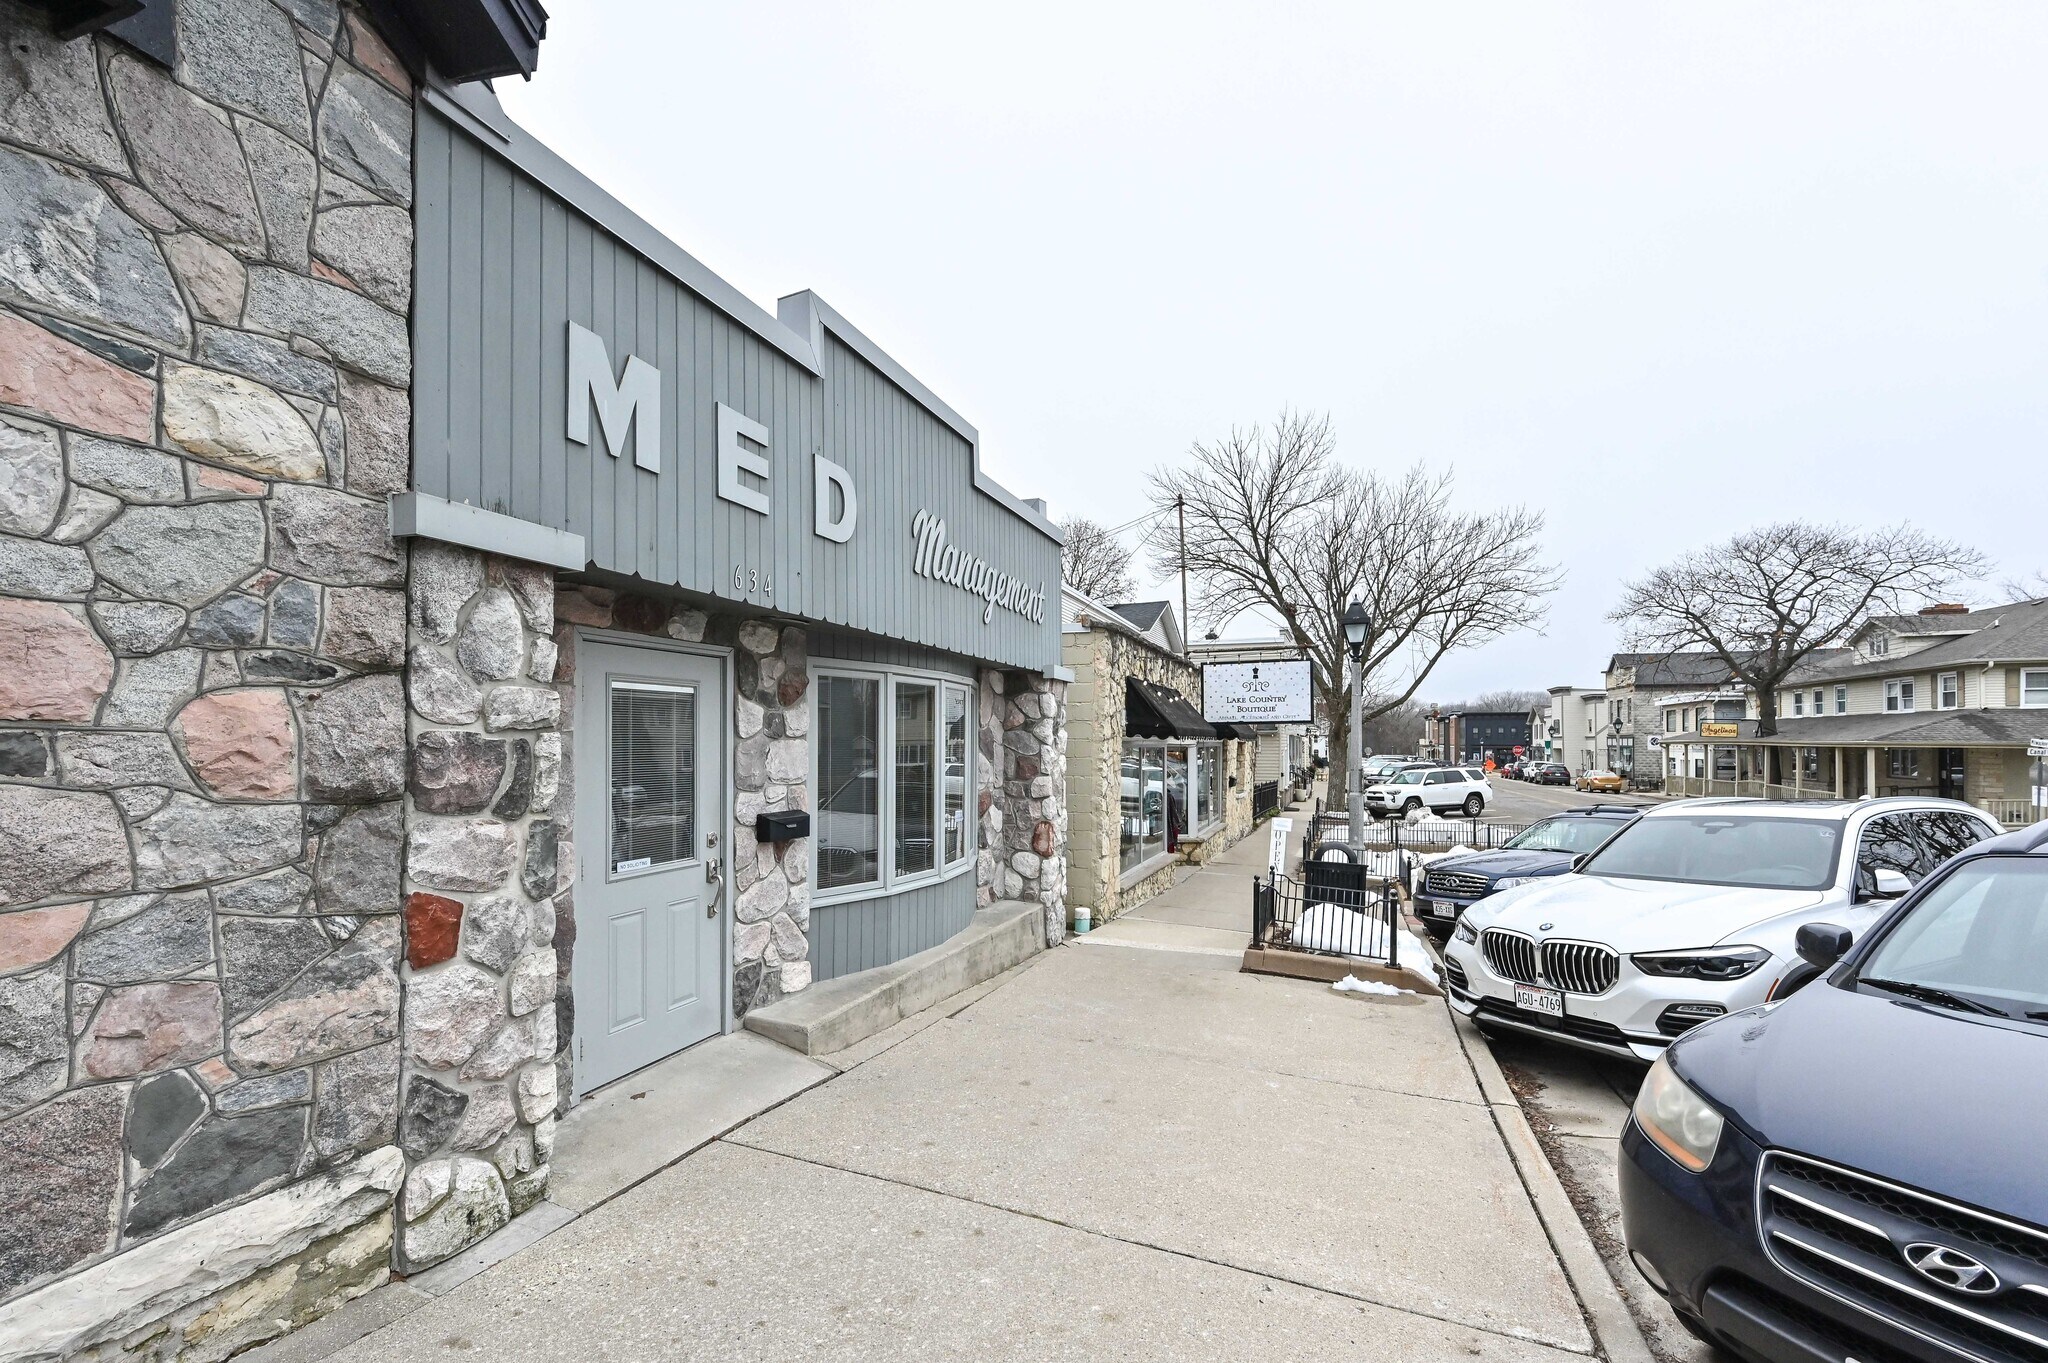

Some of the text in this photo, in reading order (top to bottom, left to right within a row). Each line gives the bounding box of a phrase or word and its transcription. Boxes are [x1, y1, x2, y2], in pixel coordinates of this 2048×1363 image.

[912, 508, 1046, 625] Management
[733, 564, 772, 598] 634
[1226, 695, 1287, 704] LAKE COUNTRY
[1237, 705, 1277, 713] BOUTIQUE
[1517, 991, 1561, 1012] AGU-4769
